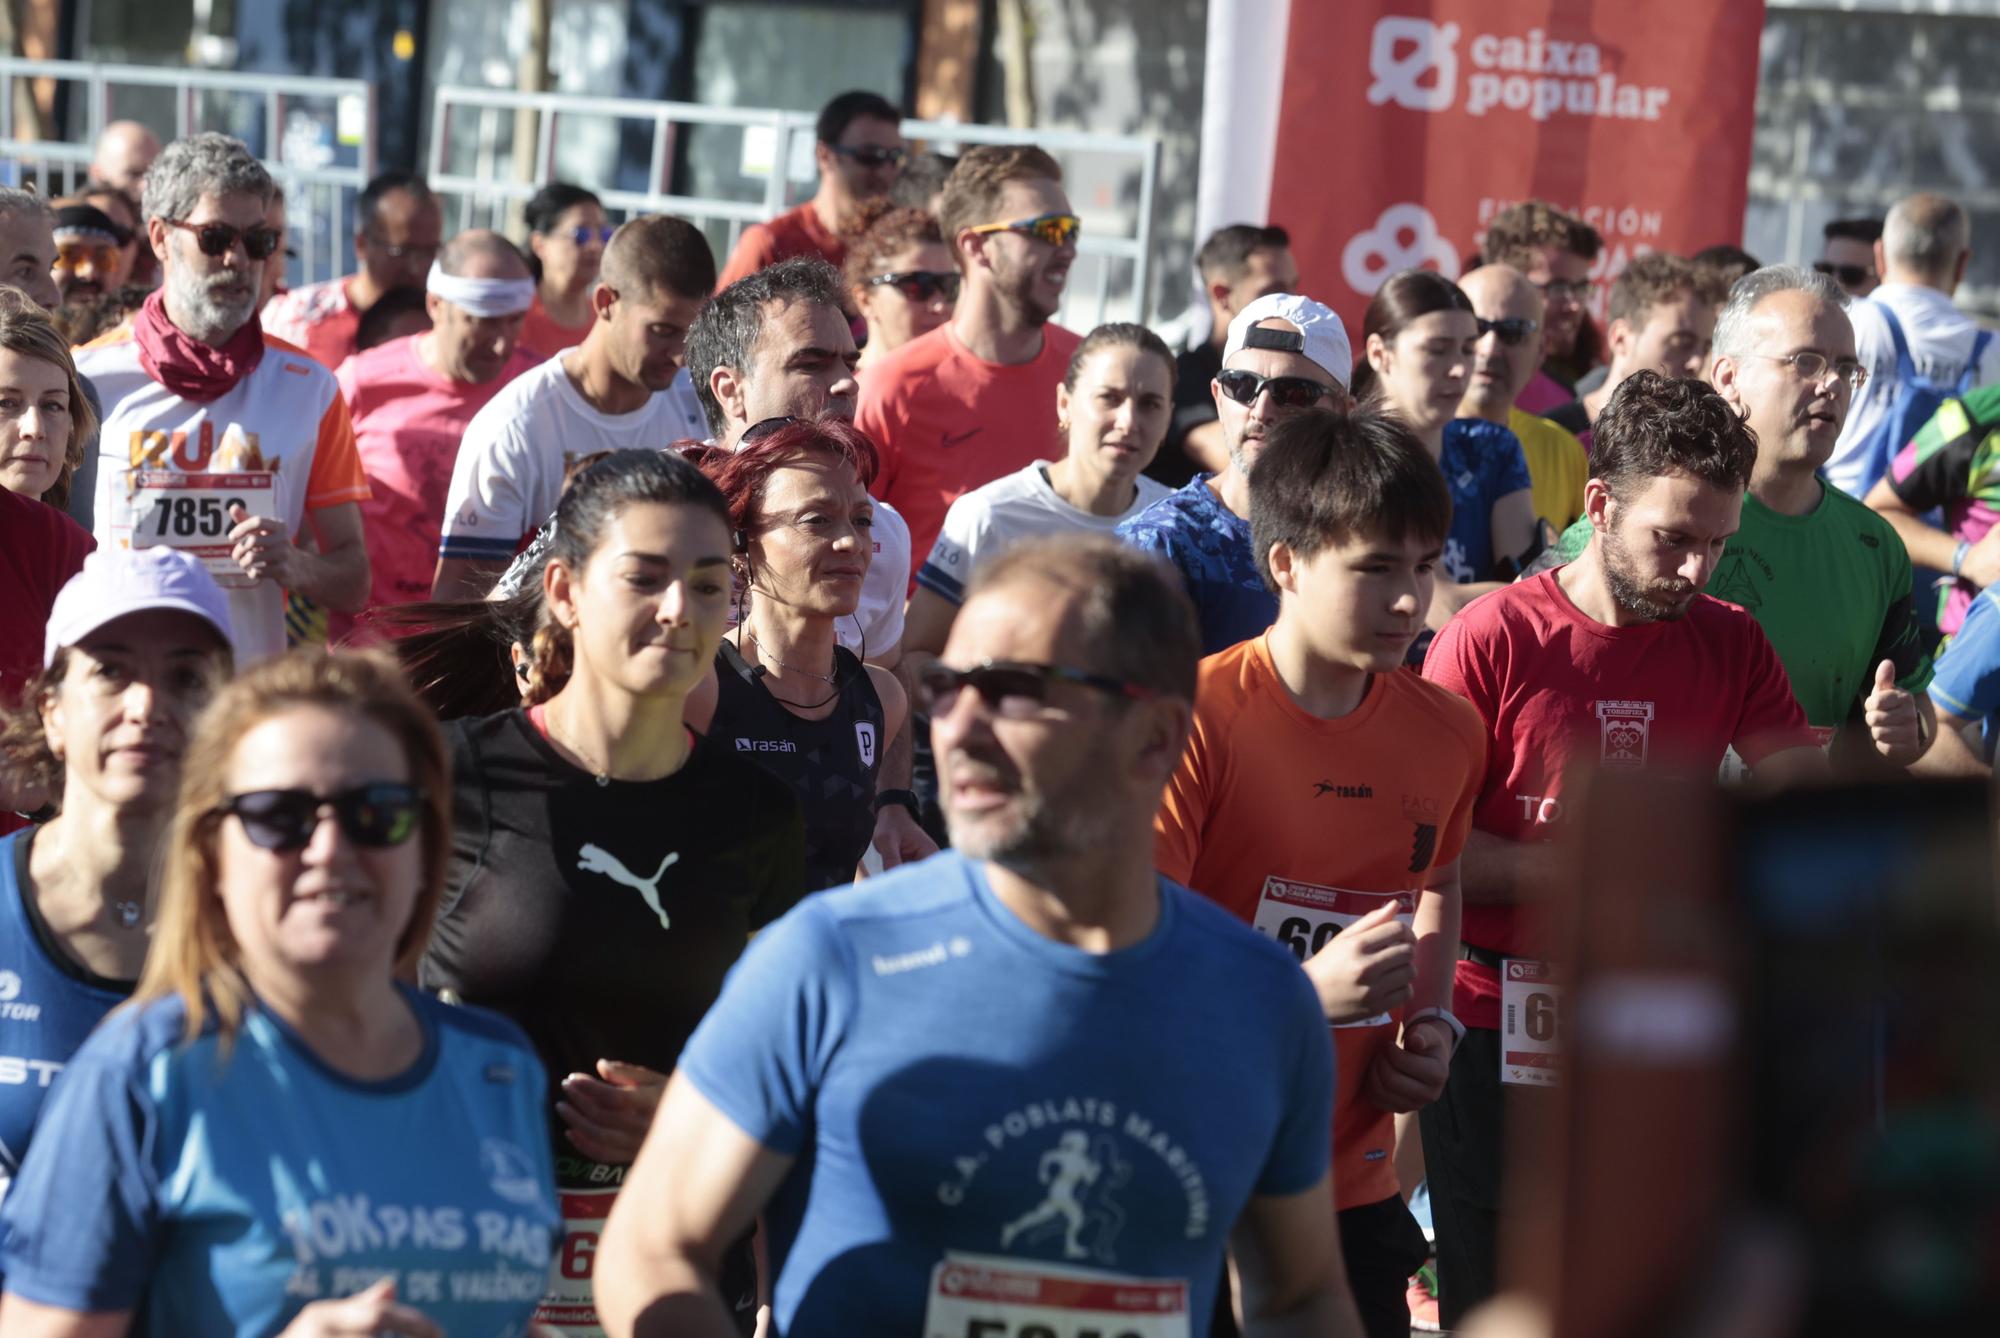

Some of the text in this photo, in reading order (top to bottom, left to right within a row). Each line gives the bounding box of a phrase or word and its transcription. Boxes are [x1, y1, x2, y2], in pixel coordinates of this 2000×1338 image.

[1470, 28, 1600, 77] caixa
[1465, 73, 1670, 120] popular
[752, 738, 797, 753] rasán
[1336, 783, 1373, 799] rasán
[984, 1096, 1117, 1149] POBLATS
